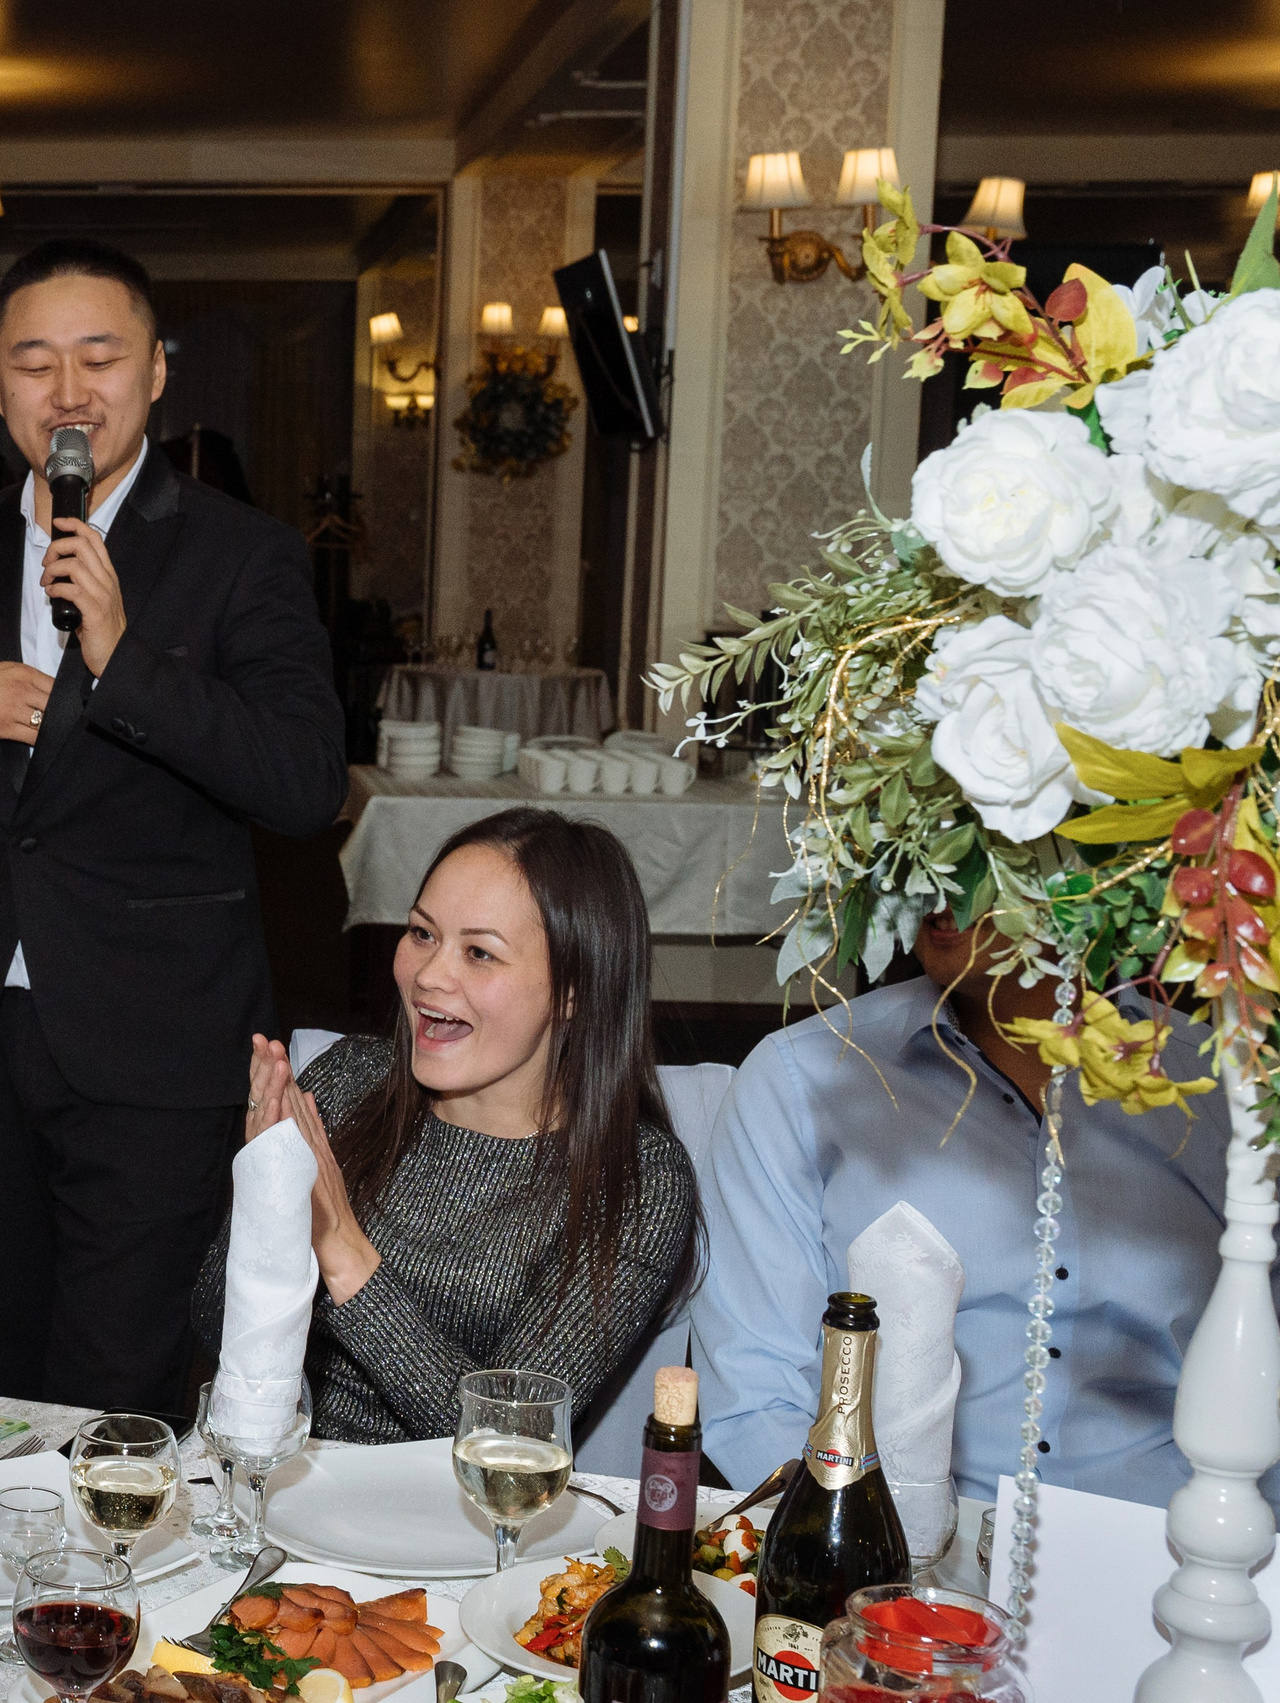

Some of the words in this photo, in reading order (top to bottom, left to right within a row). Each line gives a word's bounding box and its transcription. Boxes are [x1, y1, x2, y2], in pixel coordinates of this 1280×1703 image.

[837, 1336, 852, 1414] PROSECCO
[816, 1451, 853, 1466] MARTINI
[758, 1651, 817, 1691] MARTI
